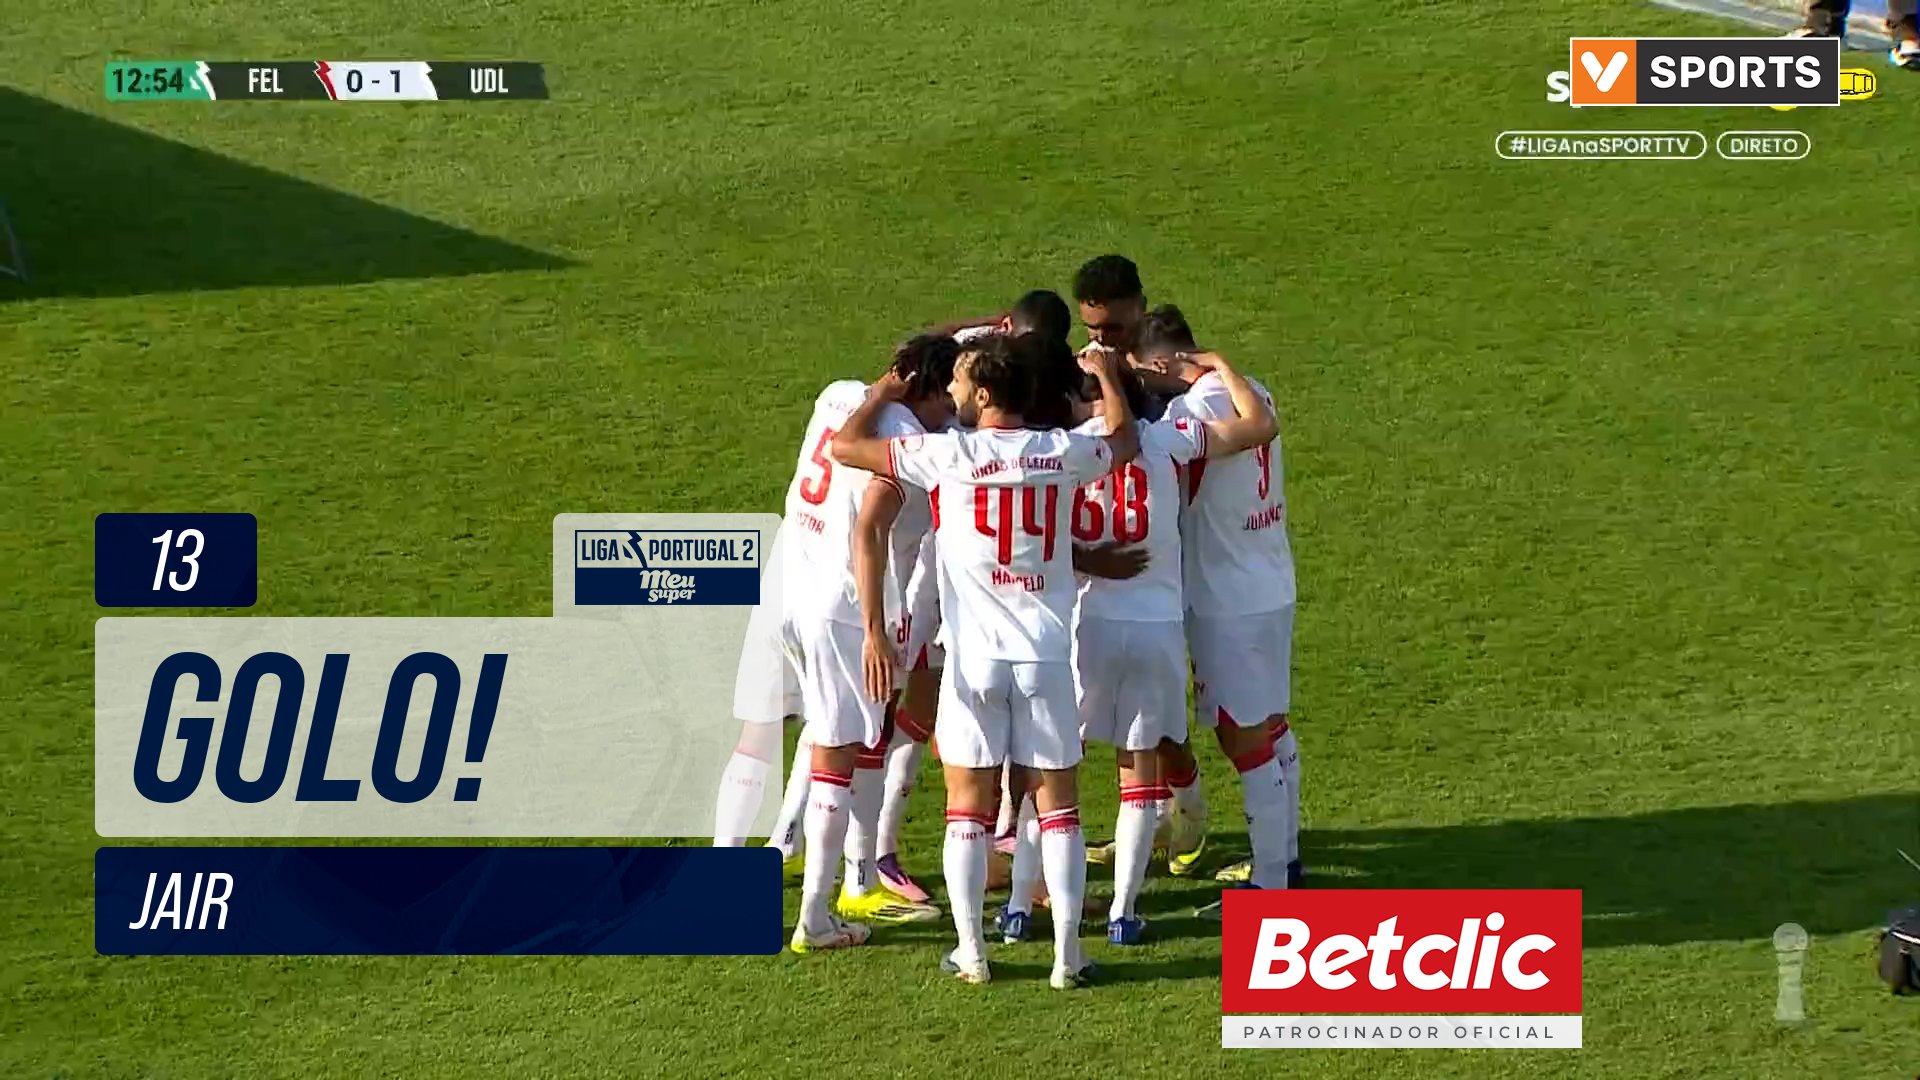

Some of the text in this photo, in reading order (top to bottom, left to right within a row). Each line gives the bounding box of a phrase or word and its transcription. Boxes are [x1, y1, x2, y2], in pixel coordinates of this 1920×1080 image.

[800, 427, 833, 505] 5
[1071, 463, 1149, 543] 68
[975, 484, 1058, 566] 44
